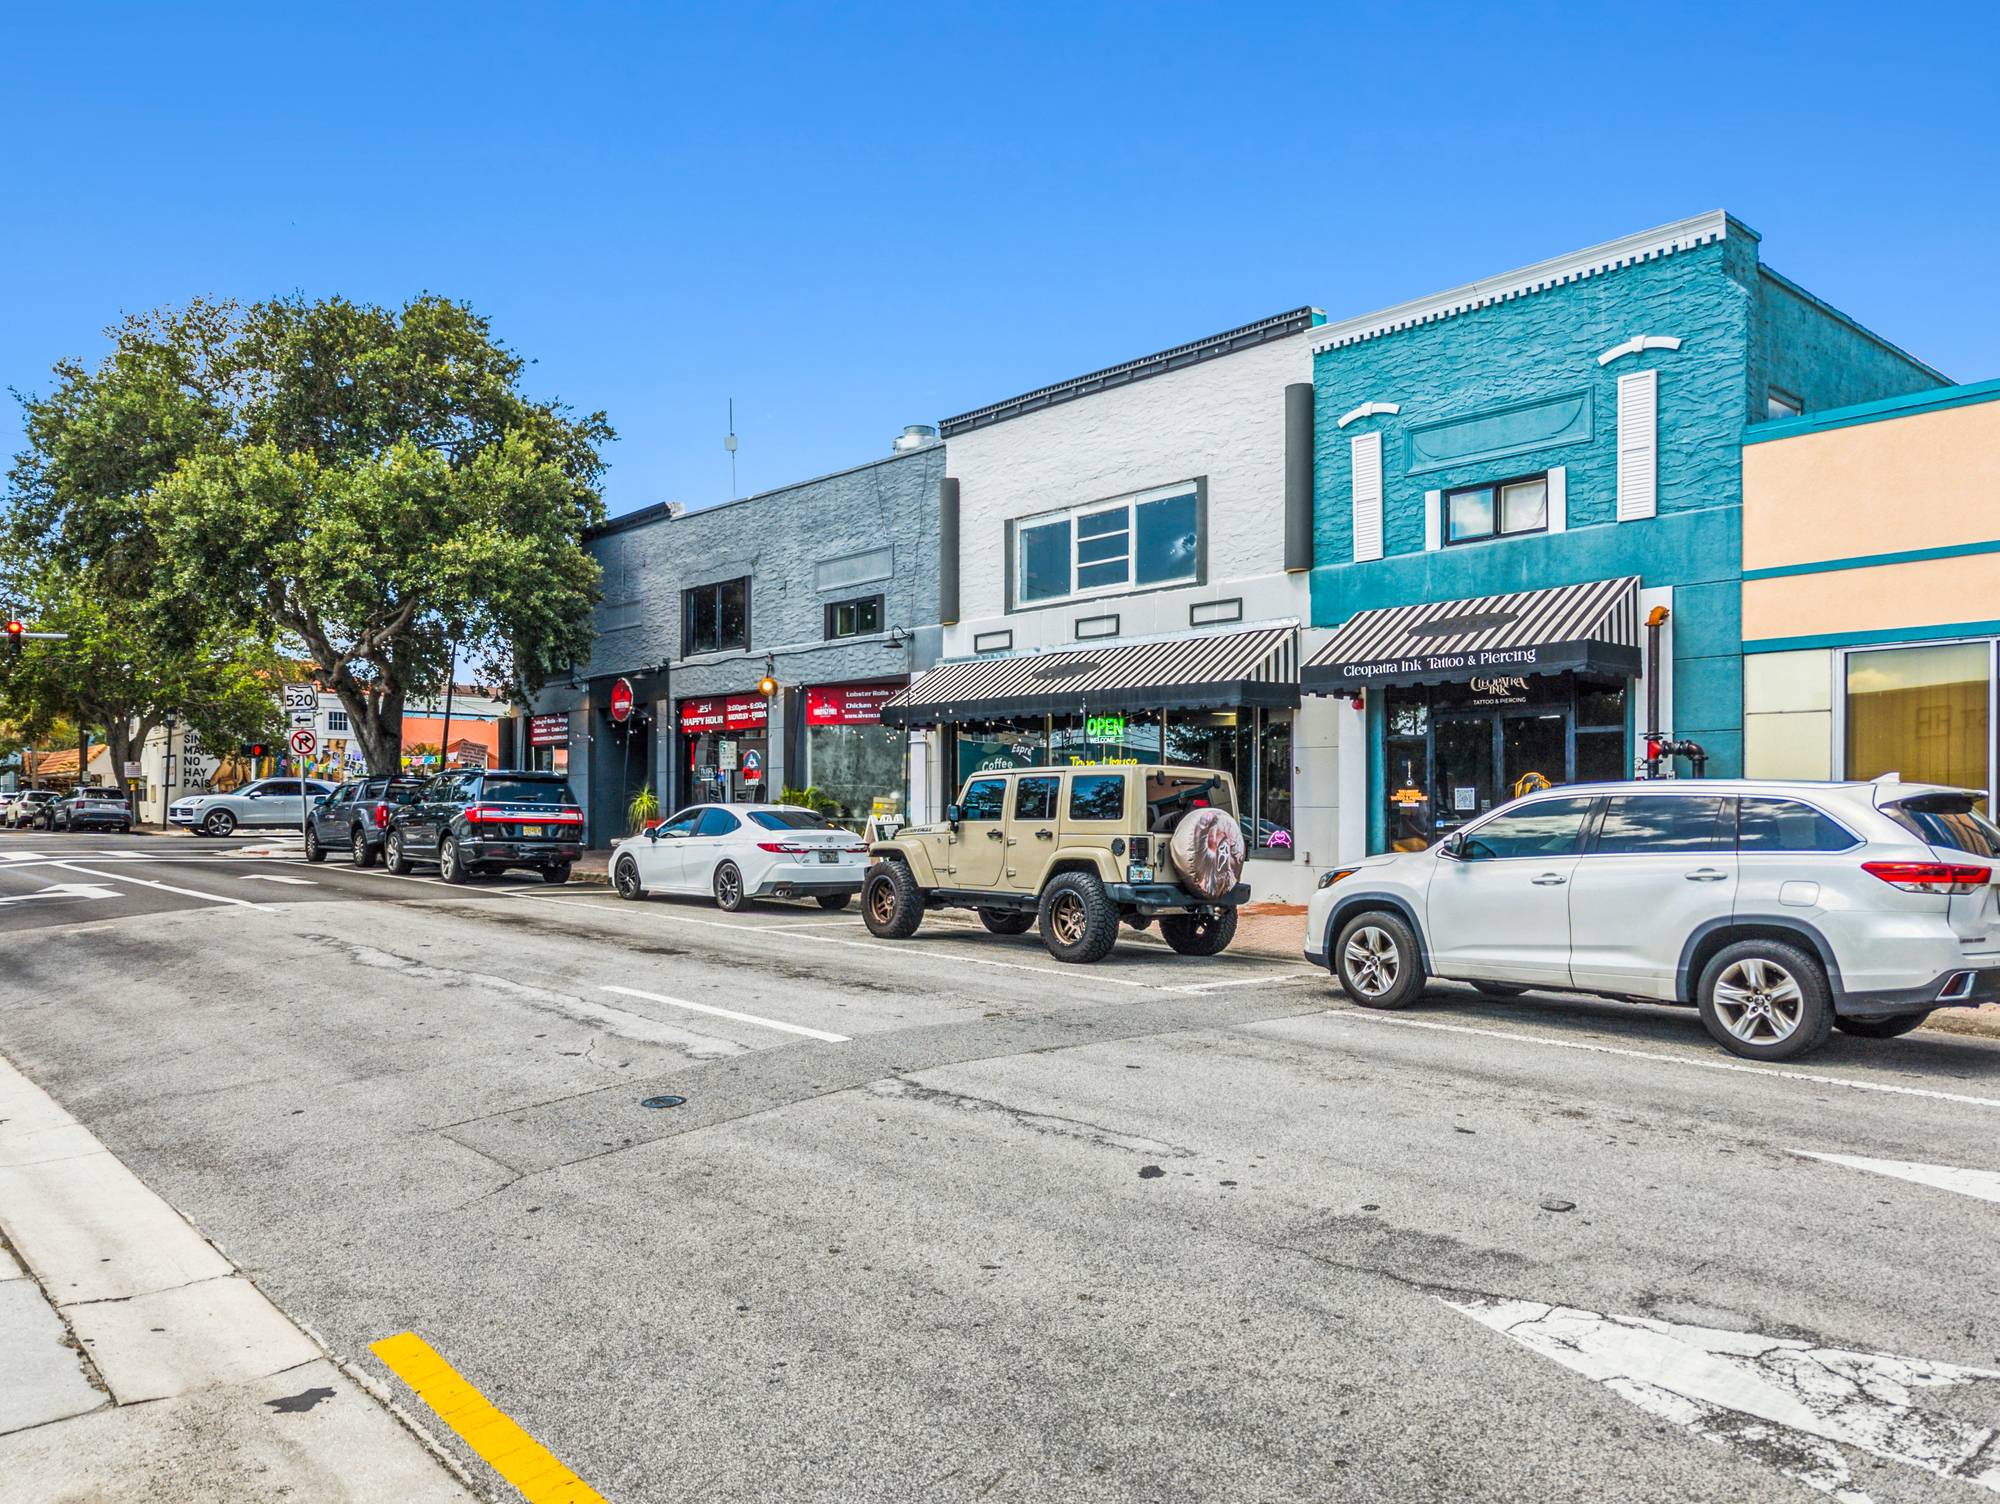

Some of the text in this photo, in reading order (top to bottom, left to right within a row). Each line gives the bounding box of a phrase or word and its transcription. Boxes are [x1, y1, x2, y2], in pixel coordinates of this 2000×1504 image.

[1343, 649, 1537, 677] Cleopatra Ink Tattoo & Piercing
[286, 694, 314, 707] 520
[1500, 696, 1527, 704] PIERCING
[683, 715, 724, 727] HAPPY HOUR
[727, 712, 749, 721] MONDAY
[1087, 717, 1125, 737] OPEN
[184, 734, 202, 744] SIN
[184, 756, 201, 766] NO
[982, 757, 1014, 771] Coffee
[184, 767, 208, 777] HAY
